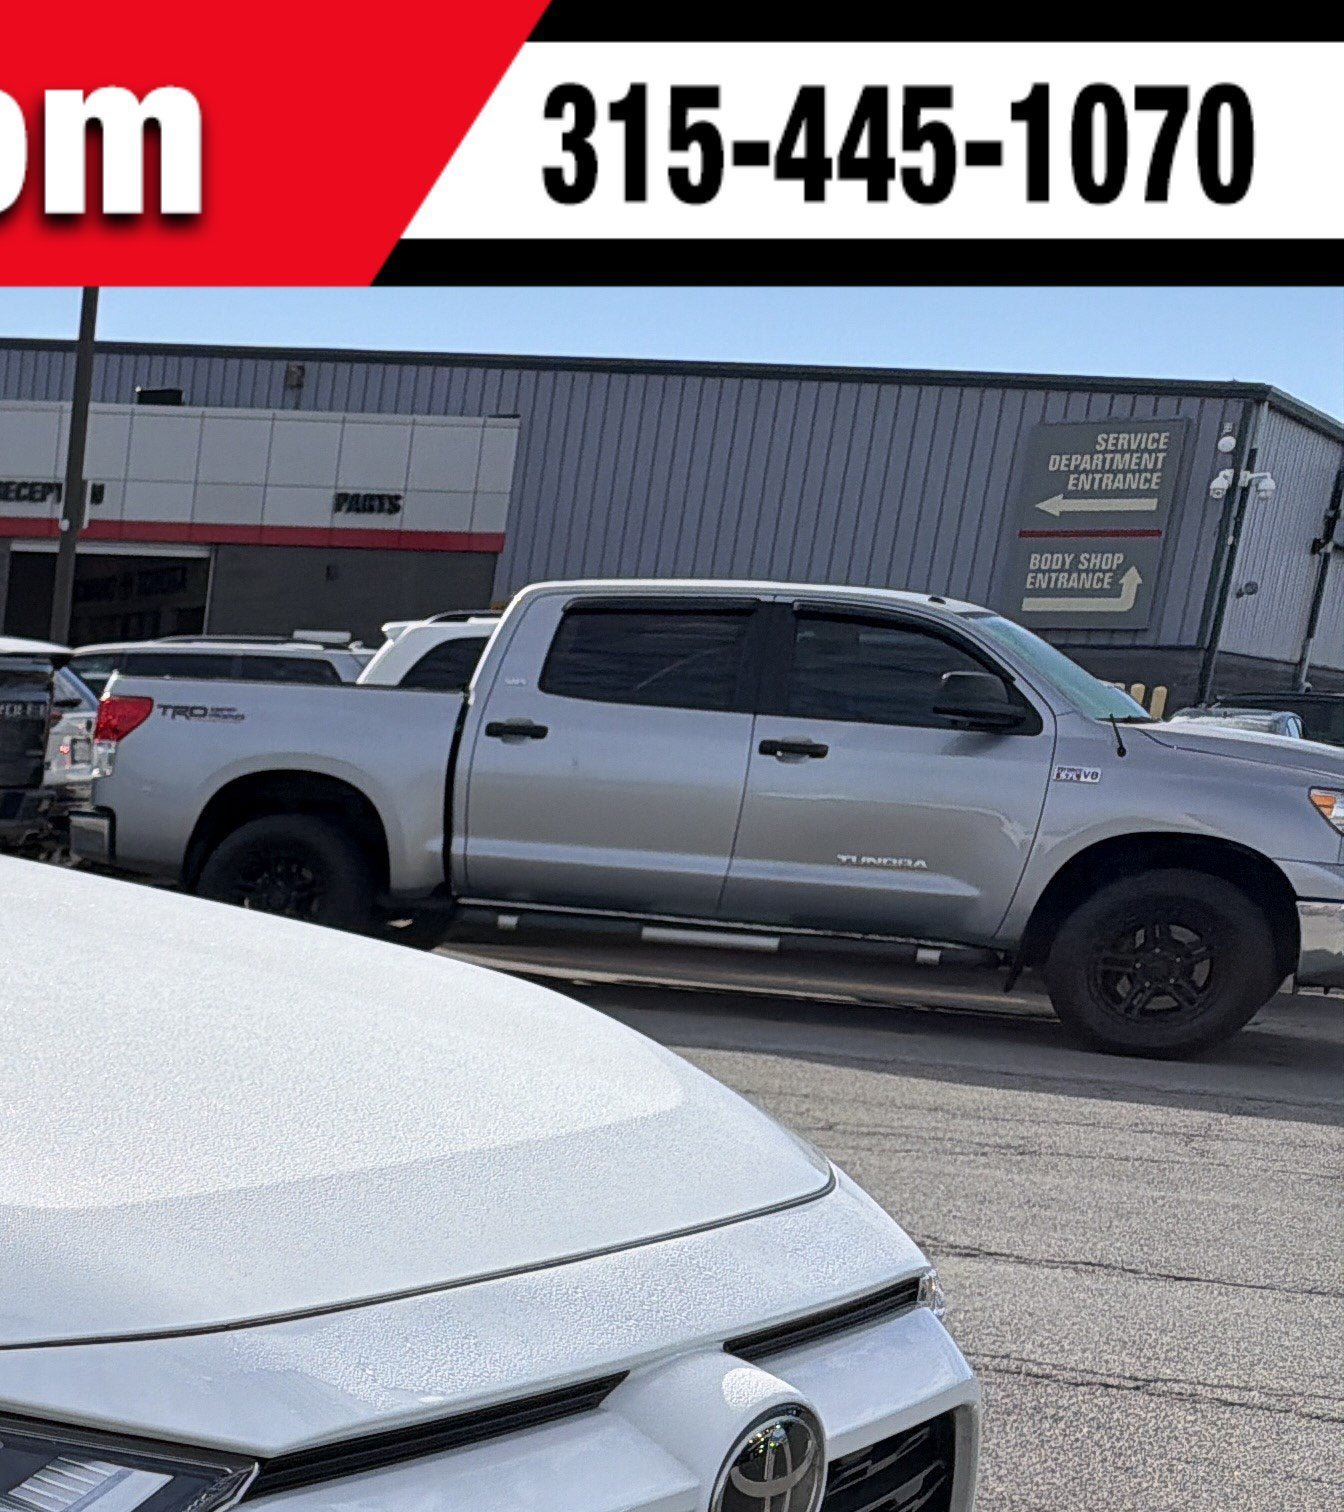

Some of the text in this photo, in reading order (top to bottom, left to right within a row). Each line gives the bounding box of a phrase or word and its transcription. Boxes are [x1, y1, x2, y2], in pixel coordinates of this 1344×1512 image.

[1095, 432, 1170, 450] SERVICE
[1048, 452, 1167, 471] DEPARTMENT
[1067, 472, 1162, 491] ENTRANCE
[333, 492, 403, 515] PARTS
[1029, 553, 1124, 570] BODY SHOP
[1026, 572, 1114, 589] ENTRANCE
